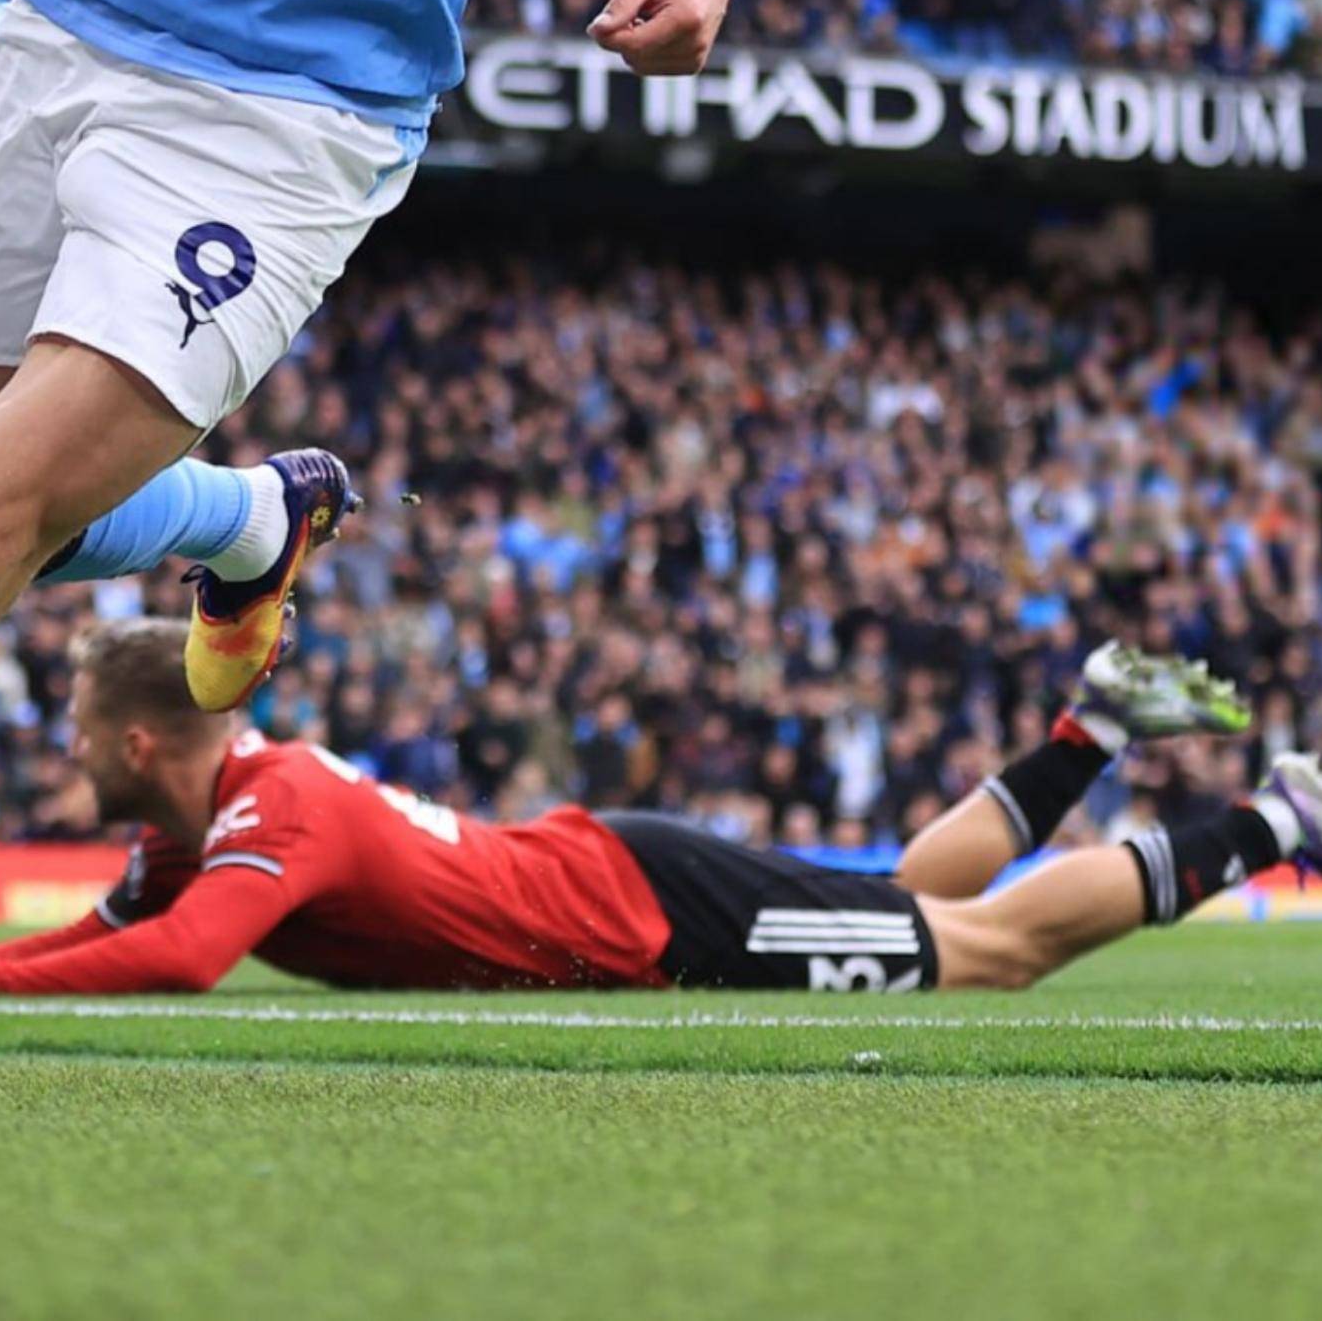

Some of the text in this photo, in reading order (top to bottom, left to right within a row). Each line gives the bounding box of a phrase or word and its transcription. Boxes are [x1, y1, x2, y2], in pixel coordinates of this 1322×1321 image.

[465, 38, 1306, 172] ETIHAD STADIUM
[175, 221, 257, 312] 9
